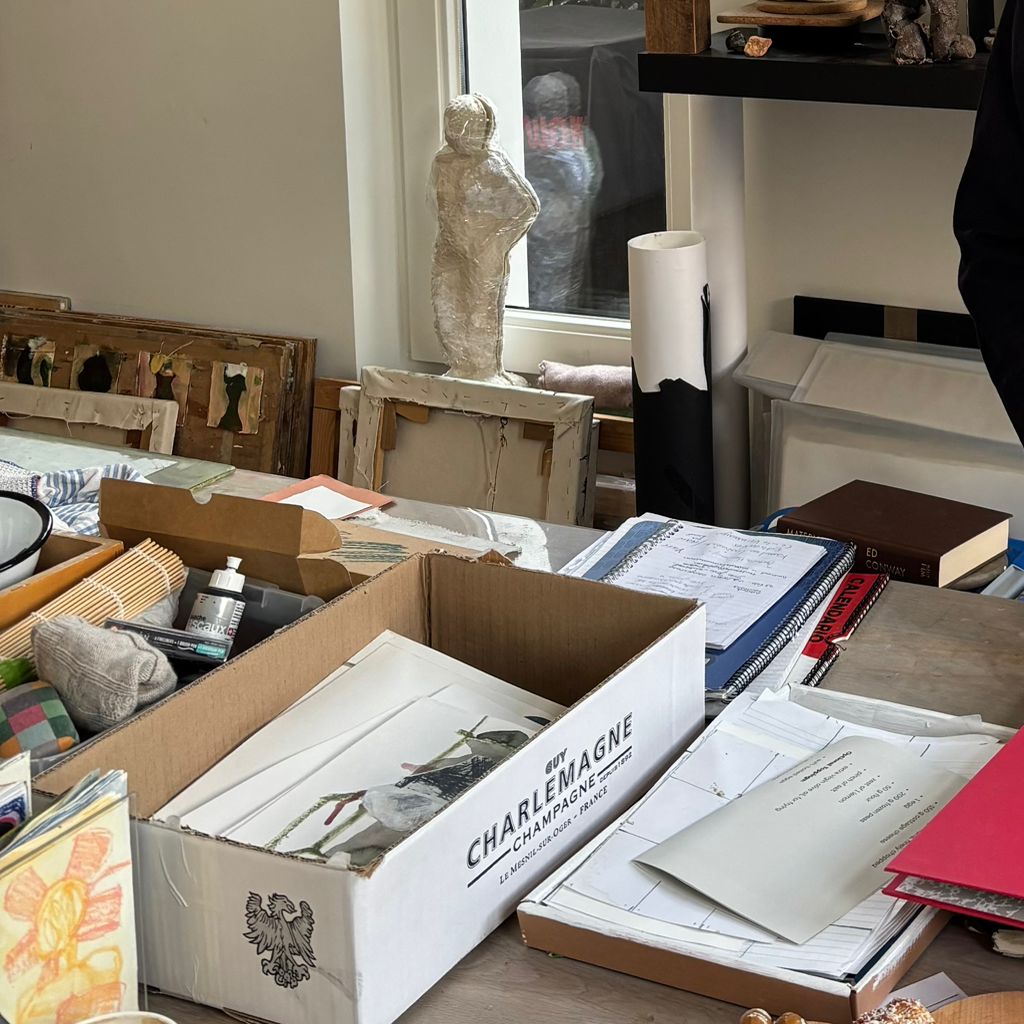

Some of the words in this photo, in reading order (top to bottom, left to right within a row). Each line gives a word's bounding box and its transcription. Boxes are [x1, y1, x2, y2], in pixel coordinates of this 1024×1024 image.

[866, 547, 878, 558] ED
[865, 559, 906, 577] CONWAY
[810, 577, 865, 643] CALENDARIO
[545, 748, 568, 775] GUY
[467, 712, 633, 869] CHARLEMAGNE
[579, 785, 609, 815] FRANCE
[513, 773, 597, 852] CHAMPAGNE
